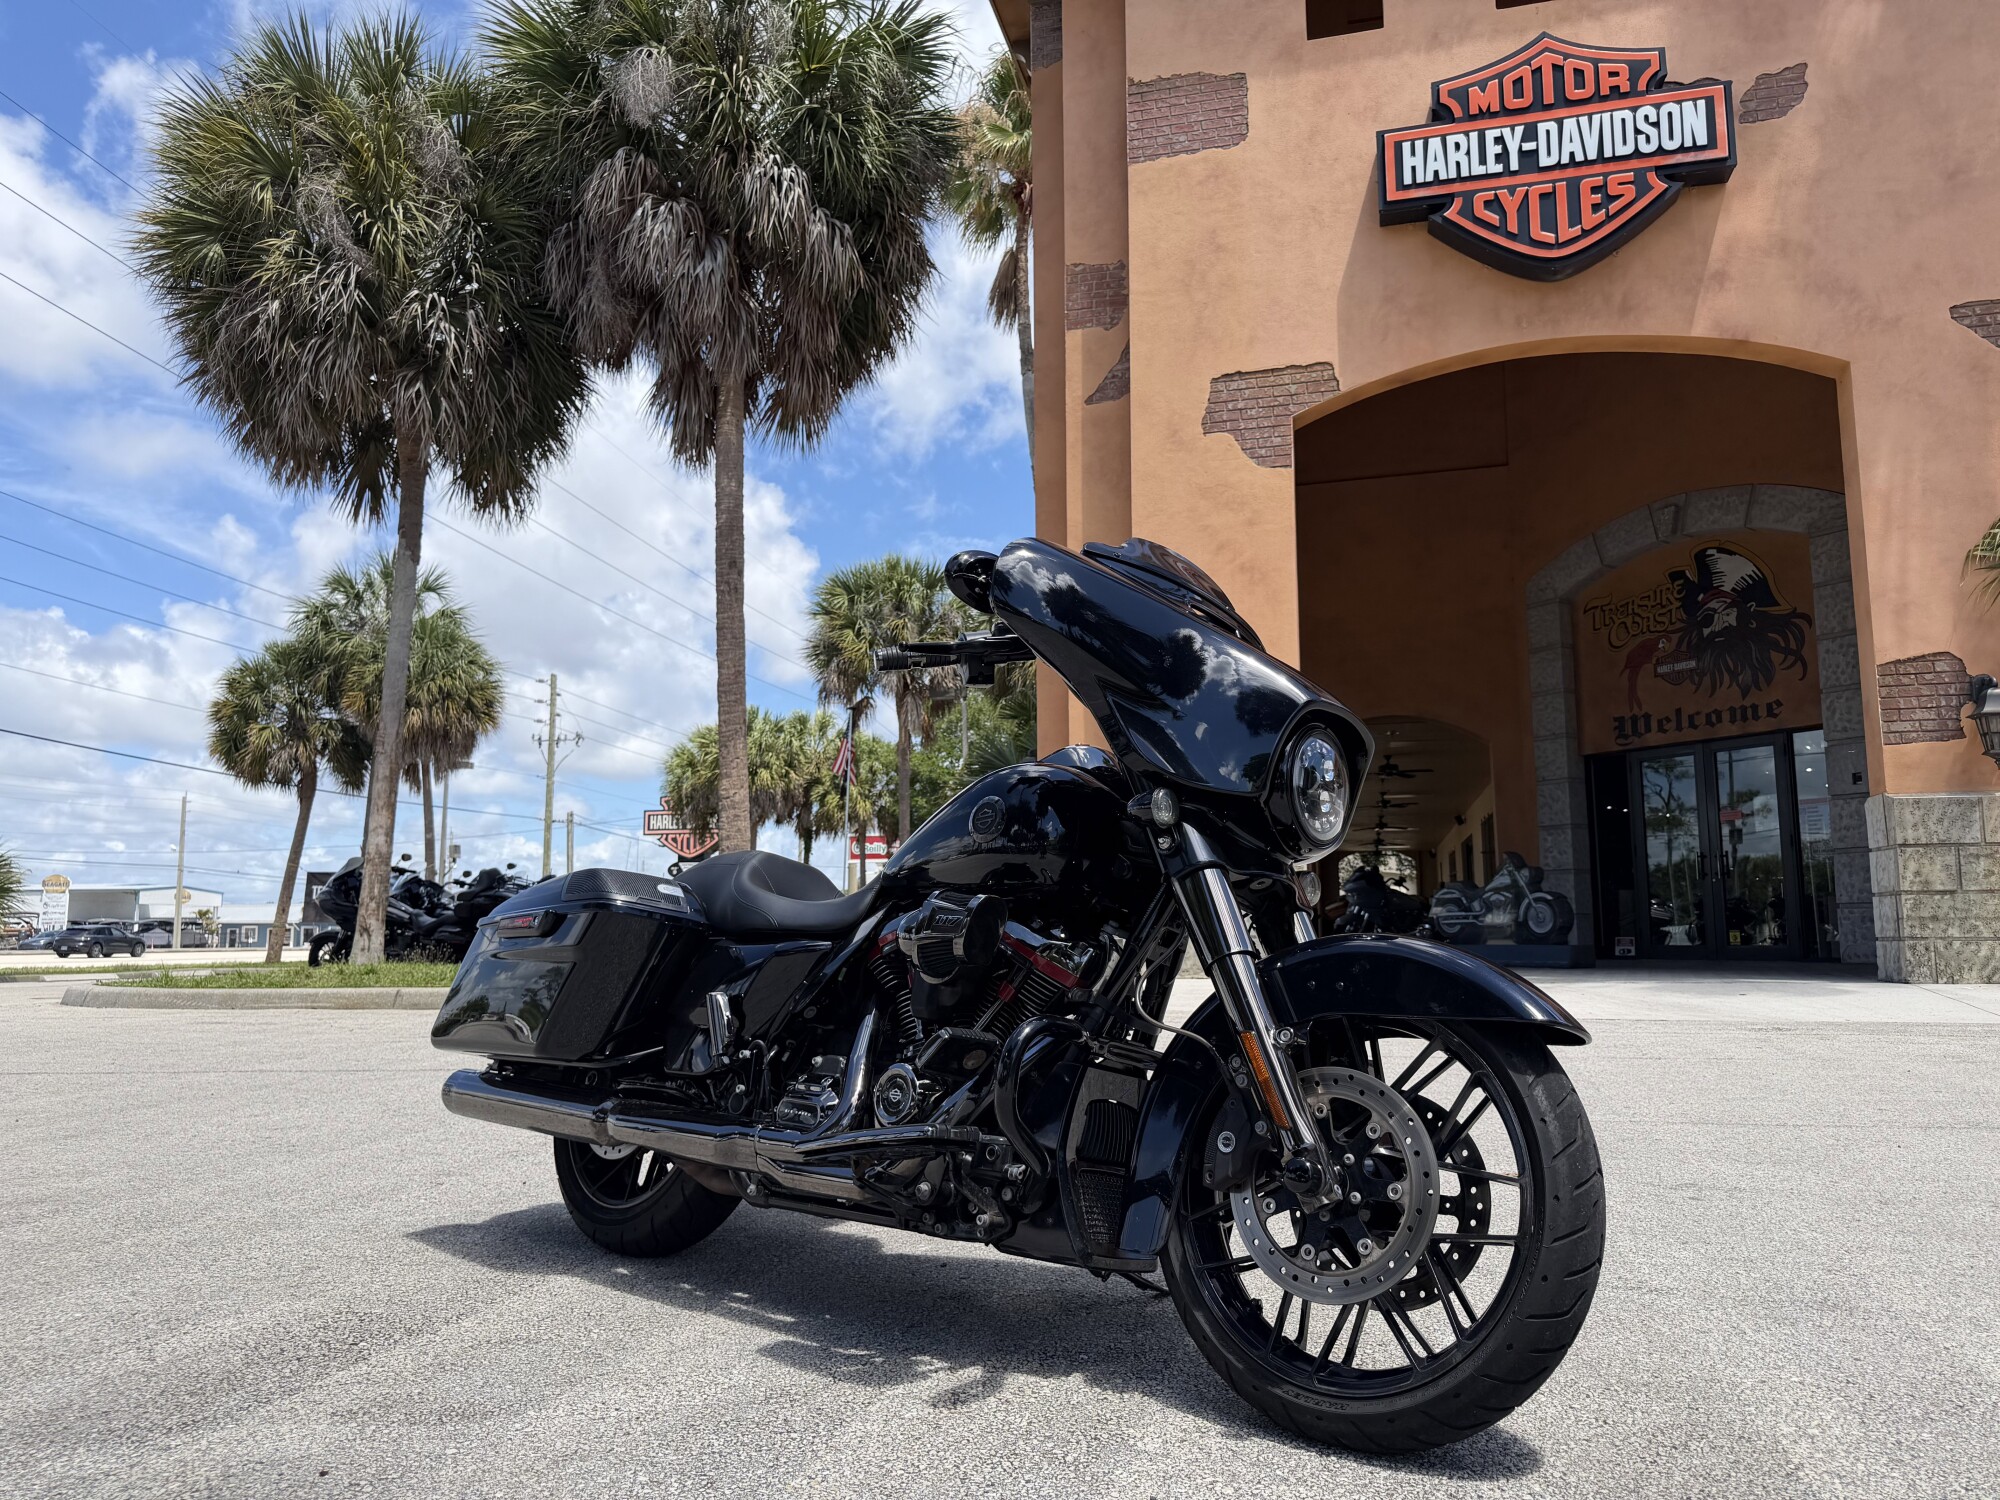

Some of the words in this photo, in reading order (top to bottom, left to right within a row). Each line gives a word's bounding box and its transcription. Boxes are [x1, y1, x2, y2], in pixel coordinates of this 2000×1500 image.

[1468, 52, 1631, 115] MOTOR
[1401, 98, 1708, 186] HARLEY-DAVIDSON
[1473, 171, 1636, 244] CYCLES
[1612, 698, 1785, 747] Welcome
[933, 914, 963, 927] 117
